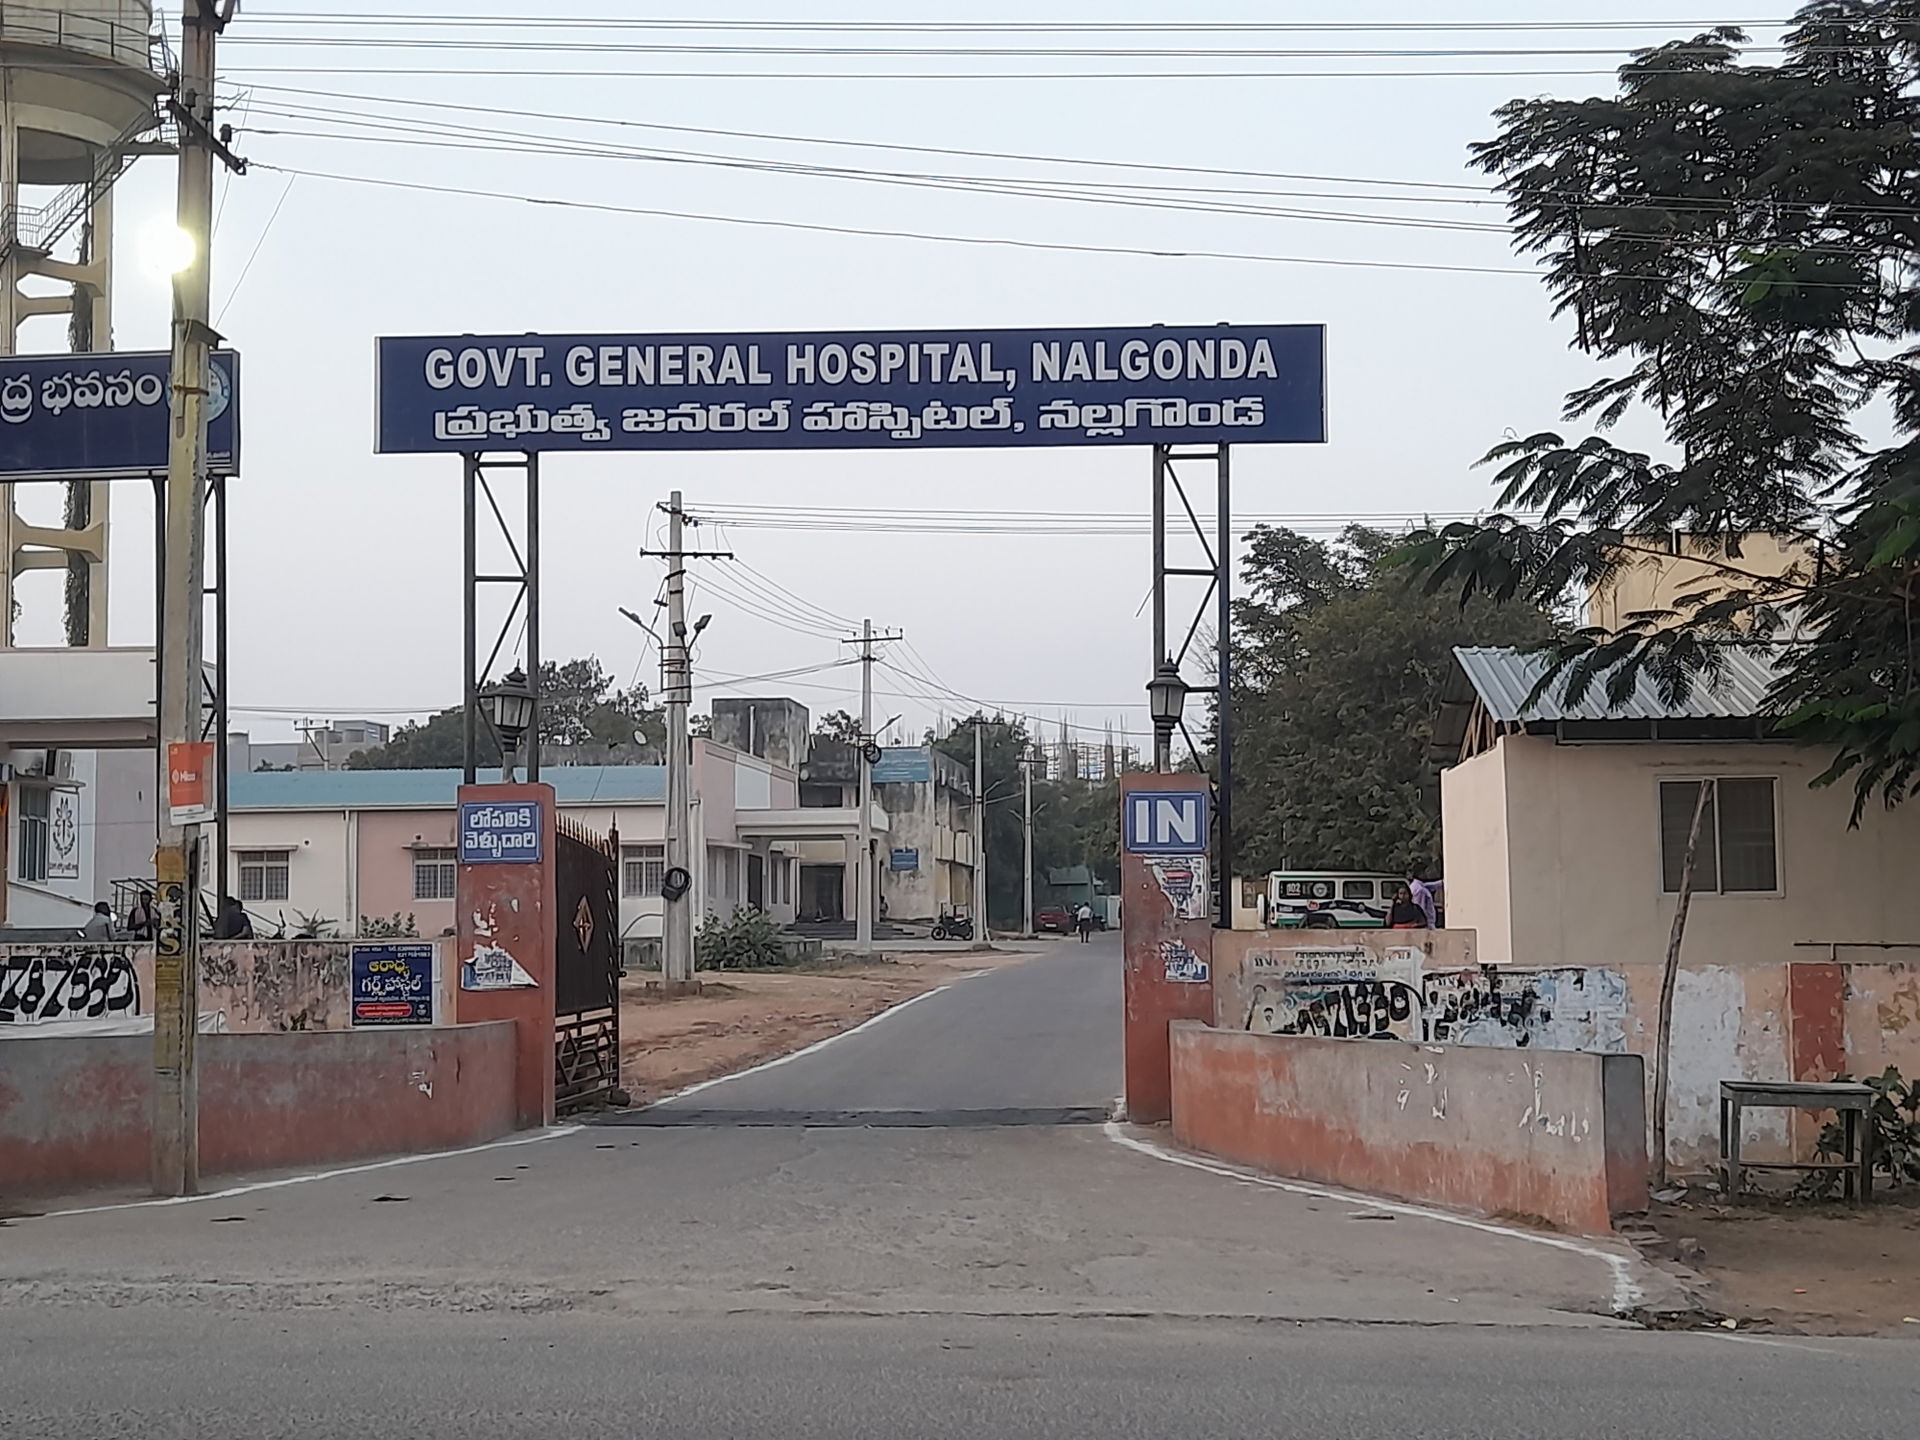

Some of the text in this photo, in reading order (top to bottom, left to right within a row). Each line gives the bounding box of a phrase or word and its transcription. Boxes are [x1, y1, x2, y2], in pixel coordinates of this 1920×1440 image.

[424, 338, 1278, 391] GOVT. GENERAL HOSPITAL, NALGONDA
[41, 368, 163, 415] భవనం
[434, 403, 612, 441] ప్రభుత్వ
[622, 399, 792, 432] జనరల్
[1039, 396, 1265, 437] నల్లగొండ
[1135, 799, 1197, 844] IN
